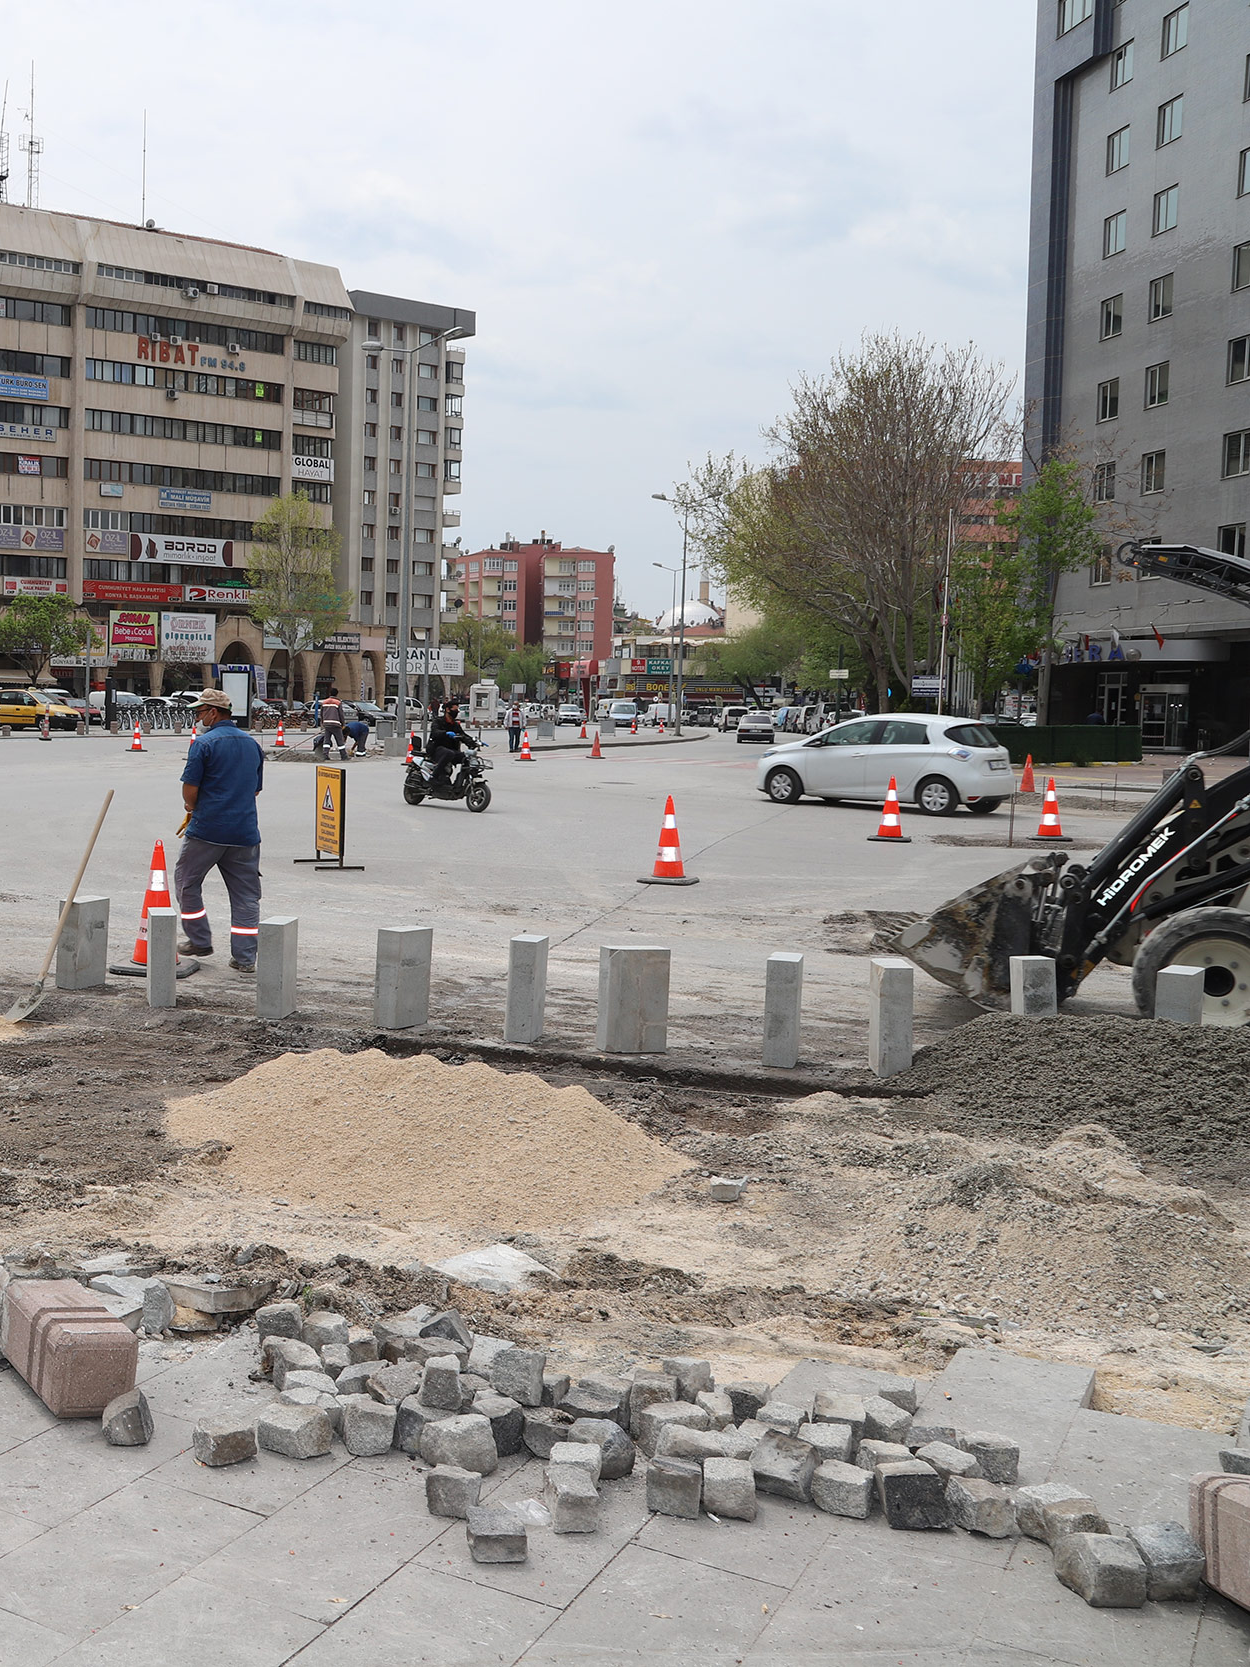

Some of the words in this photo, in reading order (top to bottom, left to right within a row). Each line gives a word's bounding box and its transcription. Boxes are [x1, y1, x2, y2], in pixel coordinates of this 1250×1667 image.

[200, 356, 217, 368] FM
[294, 457, 330, 469] GLOBAL
[297, 468, 324, 478] HAYAT
[164, 540, 217, 553] BORDO
[98, 584, 131, 592] CUMHURİYET
[170, 617, 207, 630] ÖRNEK
[114, 627, 131, 635] Bebe
[134, 627, 153, 636] Çocuk
[1096, 826, 1177, 907] HİDROMEK
